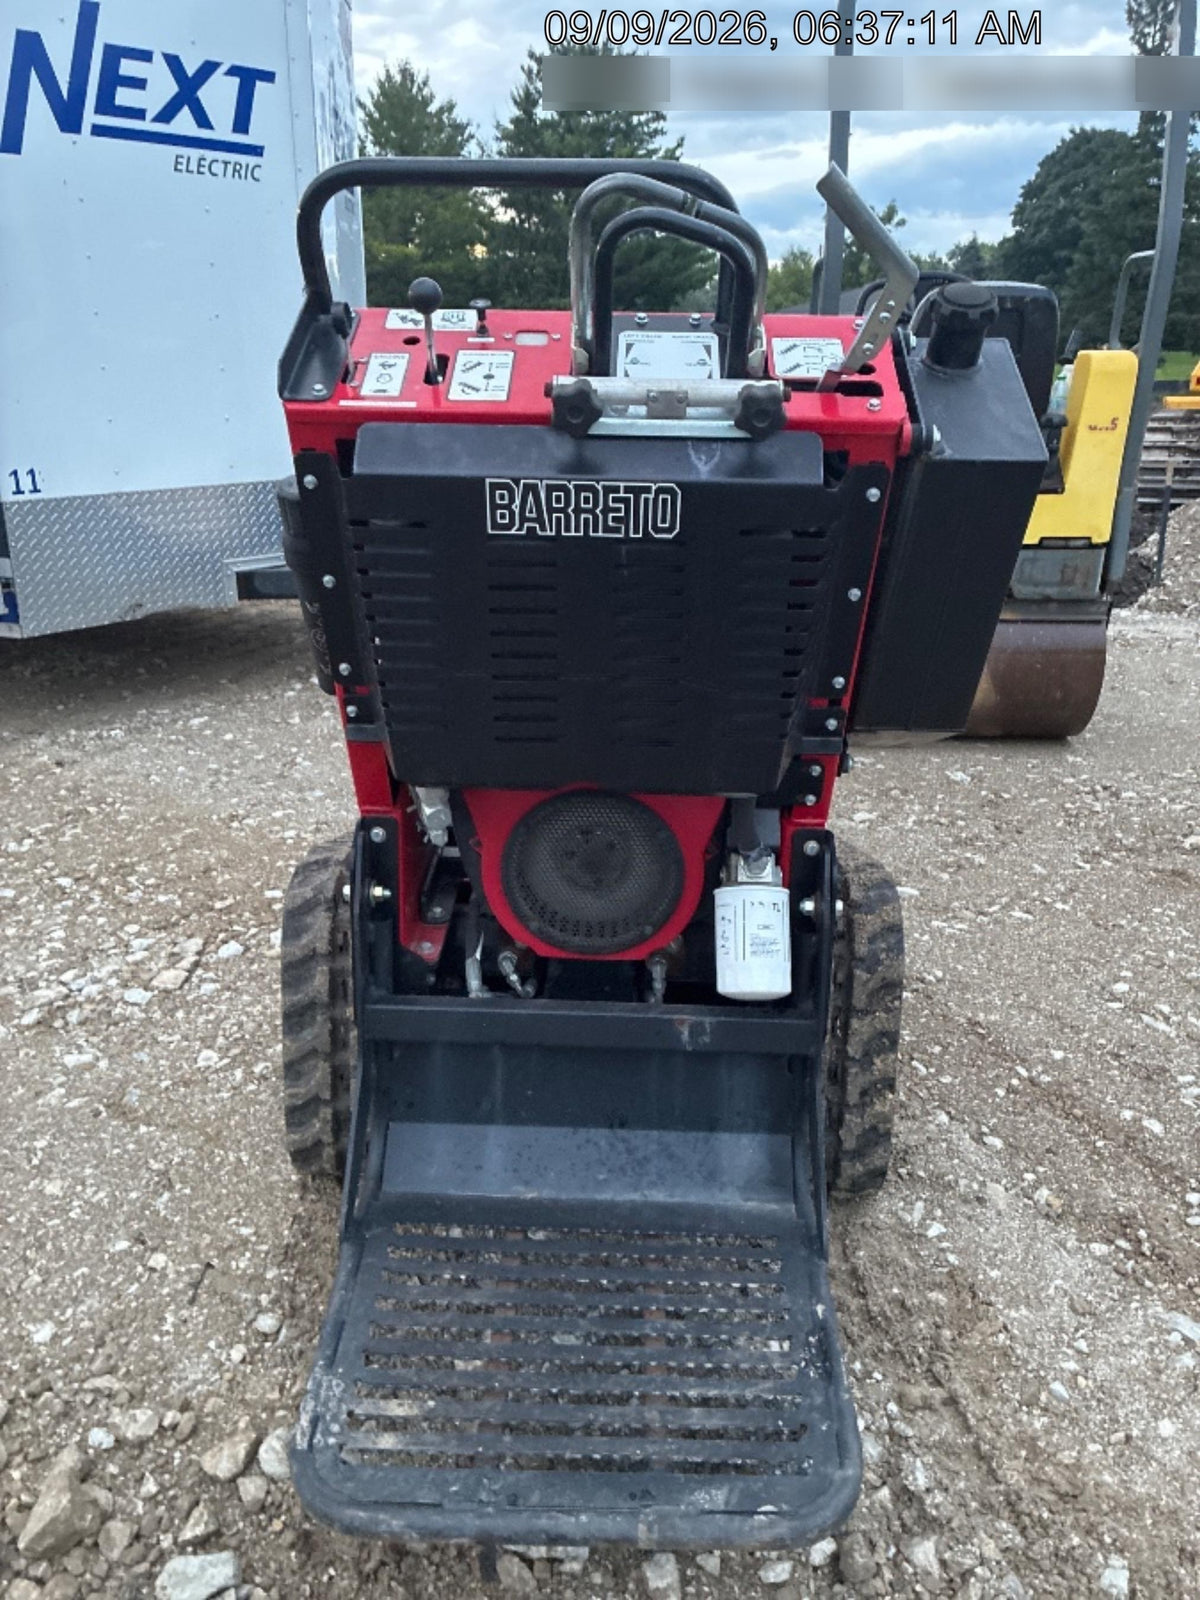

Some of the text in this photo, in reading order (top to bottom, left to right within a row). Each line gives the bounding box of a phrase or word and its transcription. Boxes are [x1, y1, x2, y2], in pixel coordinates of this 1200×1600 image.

[0, 0, 276, 155] NEXT
[8, 467, 42, 495] 11
[485, 478, 682, 540] BARRETO
